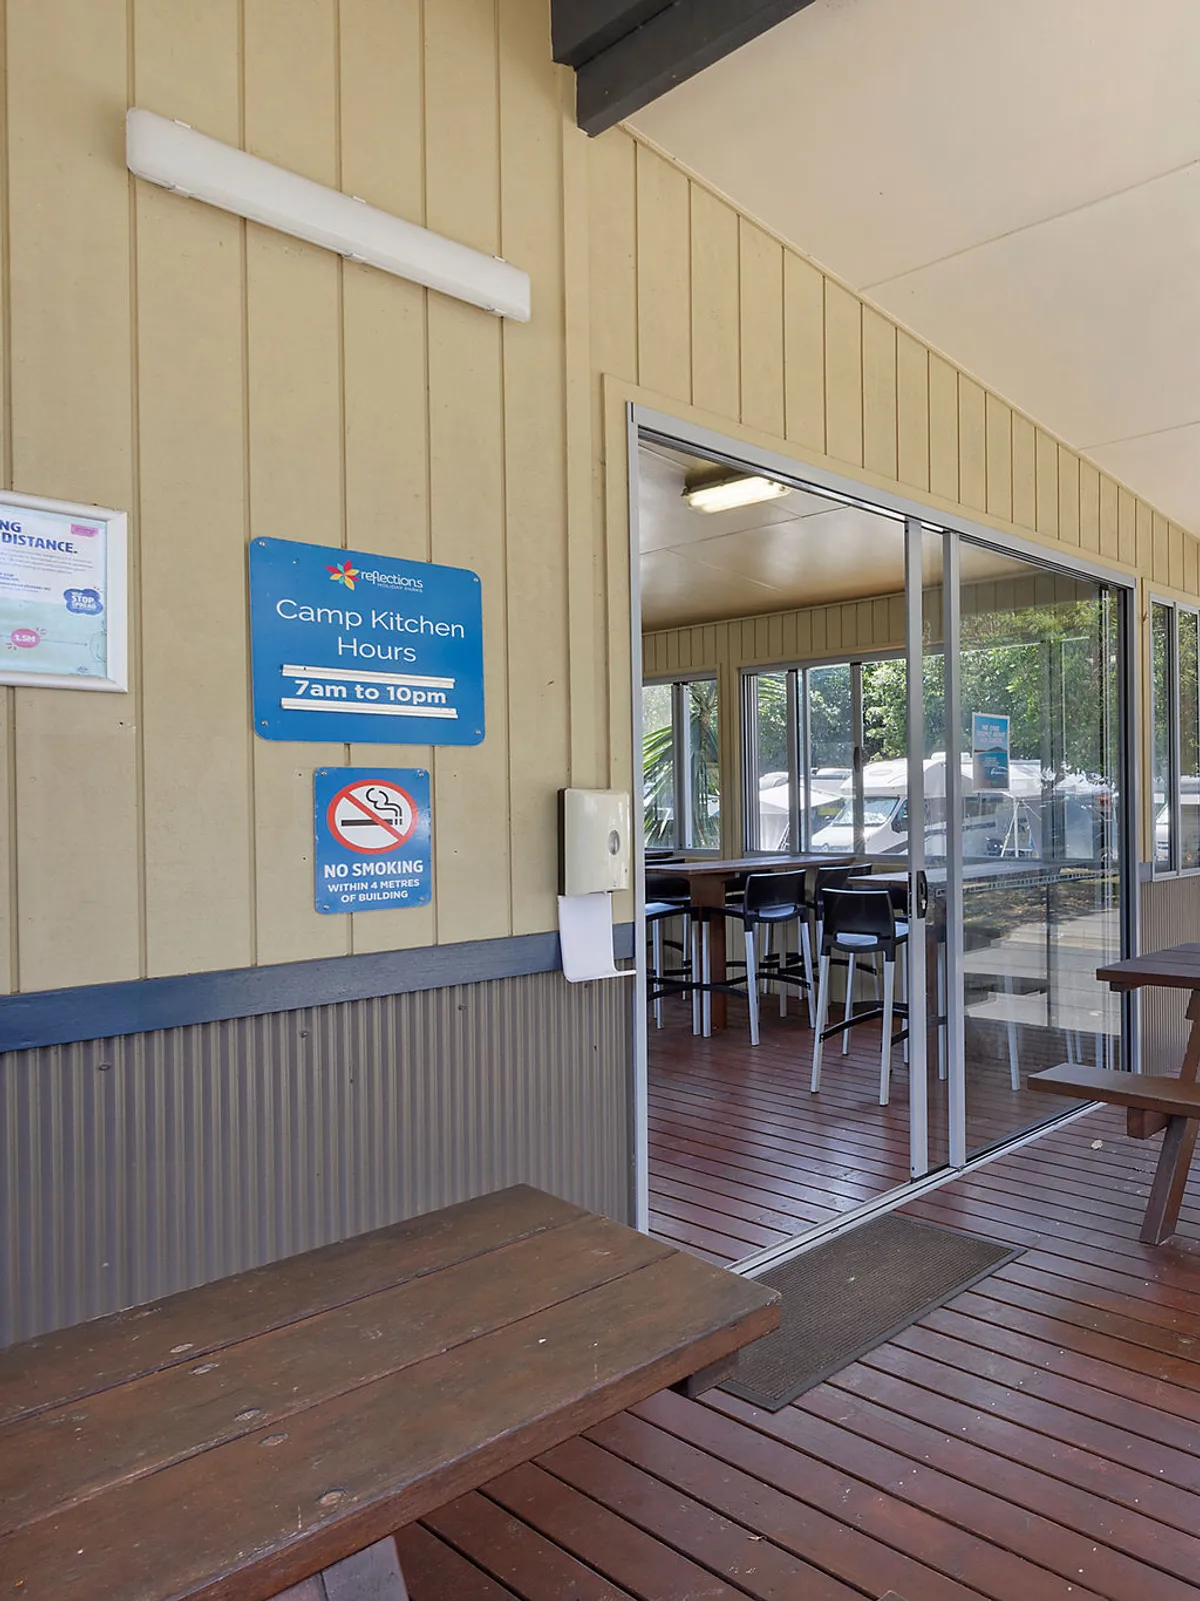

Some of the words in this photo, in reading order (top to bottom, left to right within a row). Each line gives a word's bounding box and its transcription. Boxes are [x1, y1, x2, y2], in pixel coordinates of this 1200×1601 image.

[2, 532, 78, 554] DISTANCE.
[360, 570, 423, 588] reflections
[71, 595, 94, 605] STOP
[276, 599, 363, 630] Camp
[371, 610, 465, 638] Kitchen
[338, 636, 417, 662] Hours
[294, 680, 347, 698] 7am
[355, 684, 379, 700] to
[386, 686, 447, 705] 10pm
[323, 863, 349, 879] NO
[352, 860, 424, 877] SMOKING
[328, 882, 368, 893] WITHIN
[370, 881, 378, 890] 4
[380, 878, 420, 889] METRES
[341, 894, 356, 903] OF
[358, 890, 409, 902] BUILDING
